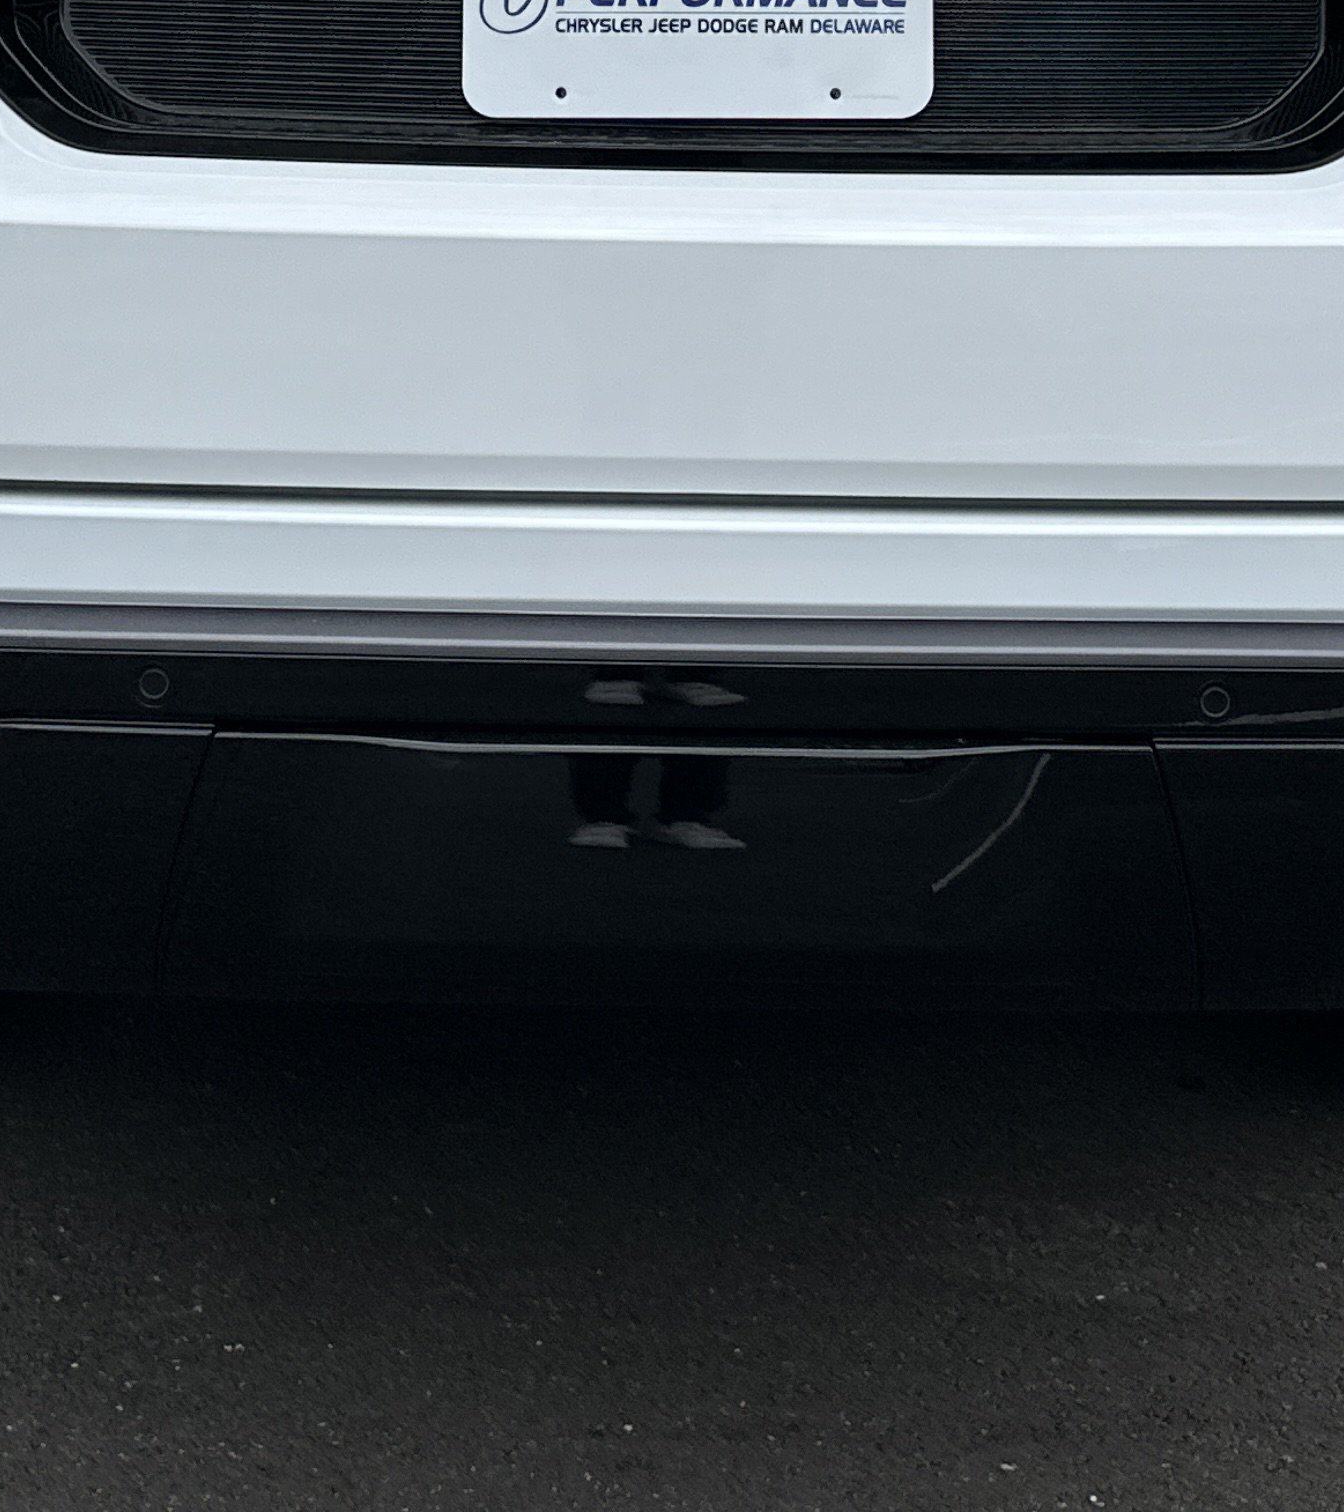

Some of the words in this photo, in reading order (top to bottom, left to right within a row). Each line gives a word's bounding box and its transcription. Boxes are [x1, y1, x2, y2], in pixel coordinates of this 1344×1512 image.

[555, 17, 643, 34] CHRYSLER
[648, 18, 692, 34] JEEP
[697, 18, 759, 34] DODGE
[764, 18, 804, 34] RAM
[810, 18, 906, 35] DELAWARE
